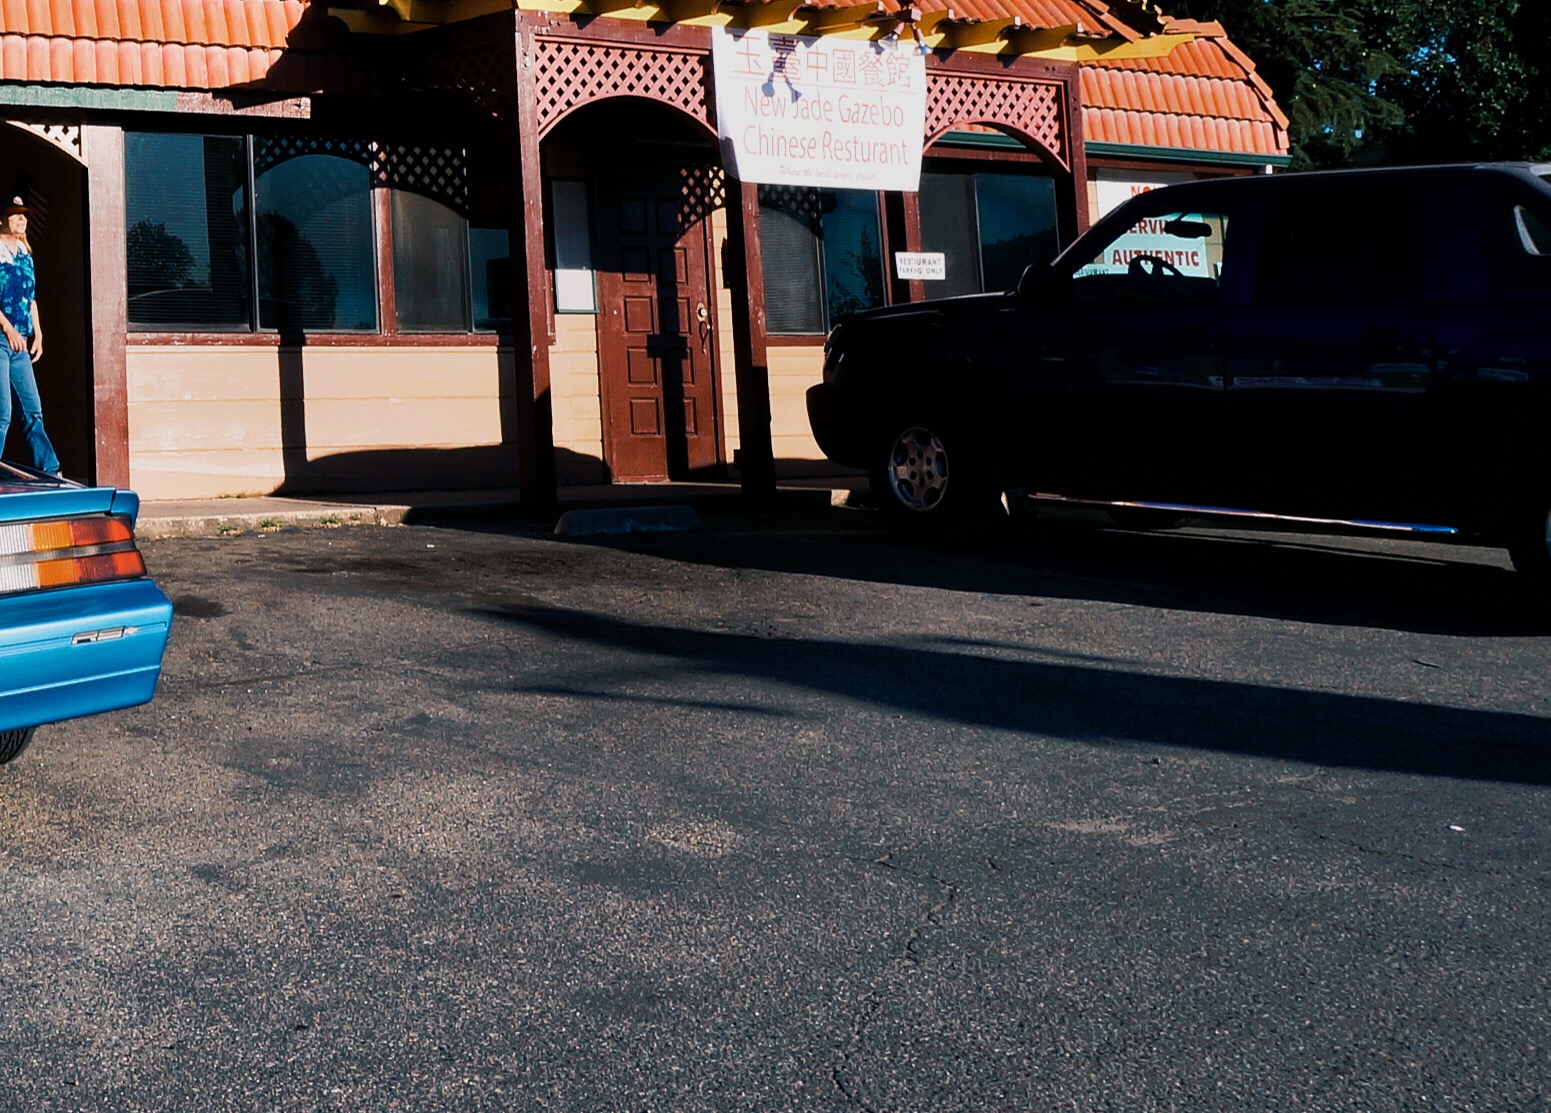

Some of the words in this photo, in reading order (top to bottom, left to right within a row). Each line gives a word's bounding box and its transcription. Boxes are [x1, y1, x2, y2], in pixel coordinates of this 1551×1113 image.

[744, 85, 786, 119] New
[792, 90, 833, 123] Jade
[839, 94, 904, 127] Gazebo
[743, 124, 816, 159] Chinese
[822, 130, 908, 166] Resturant
[926, 267, 943, 275] ONLY
